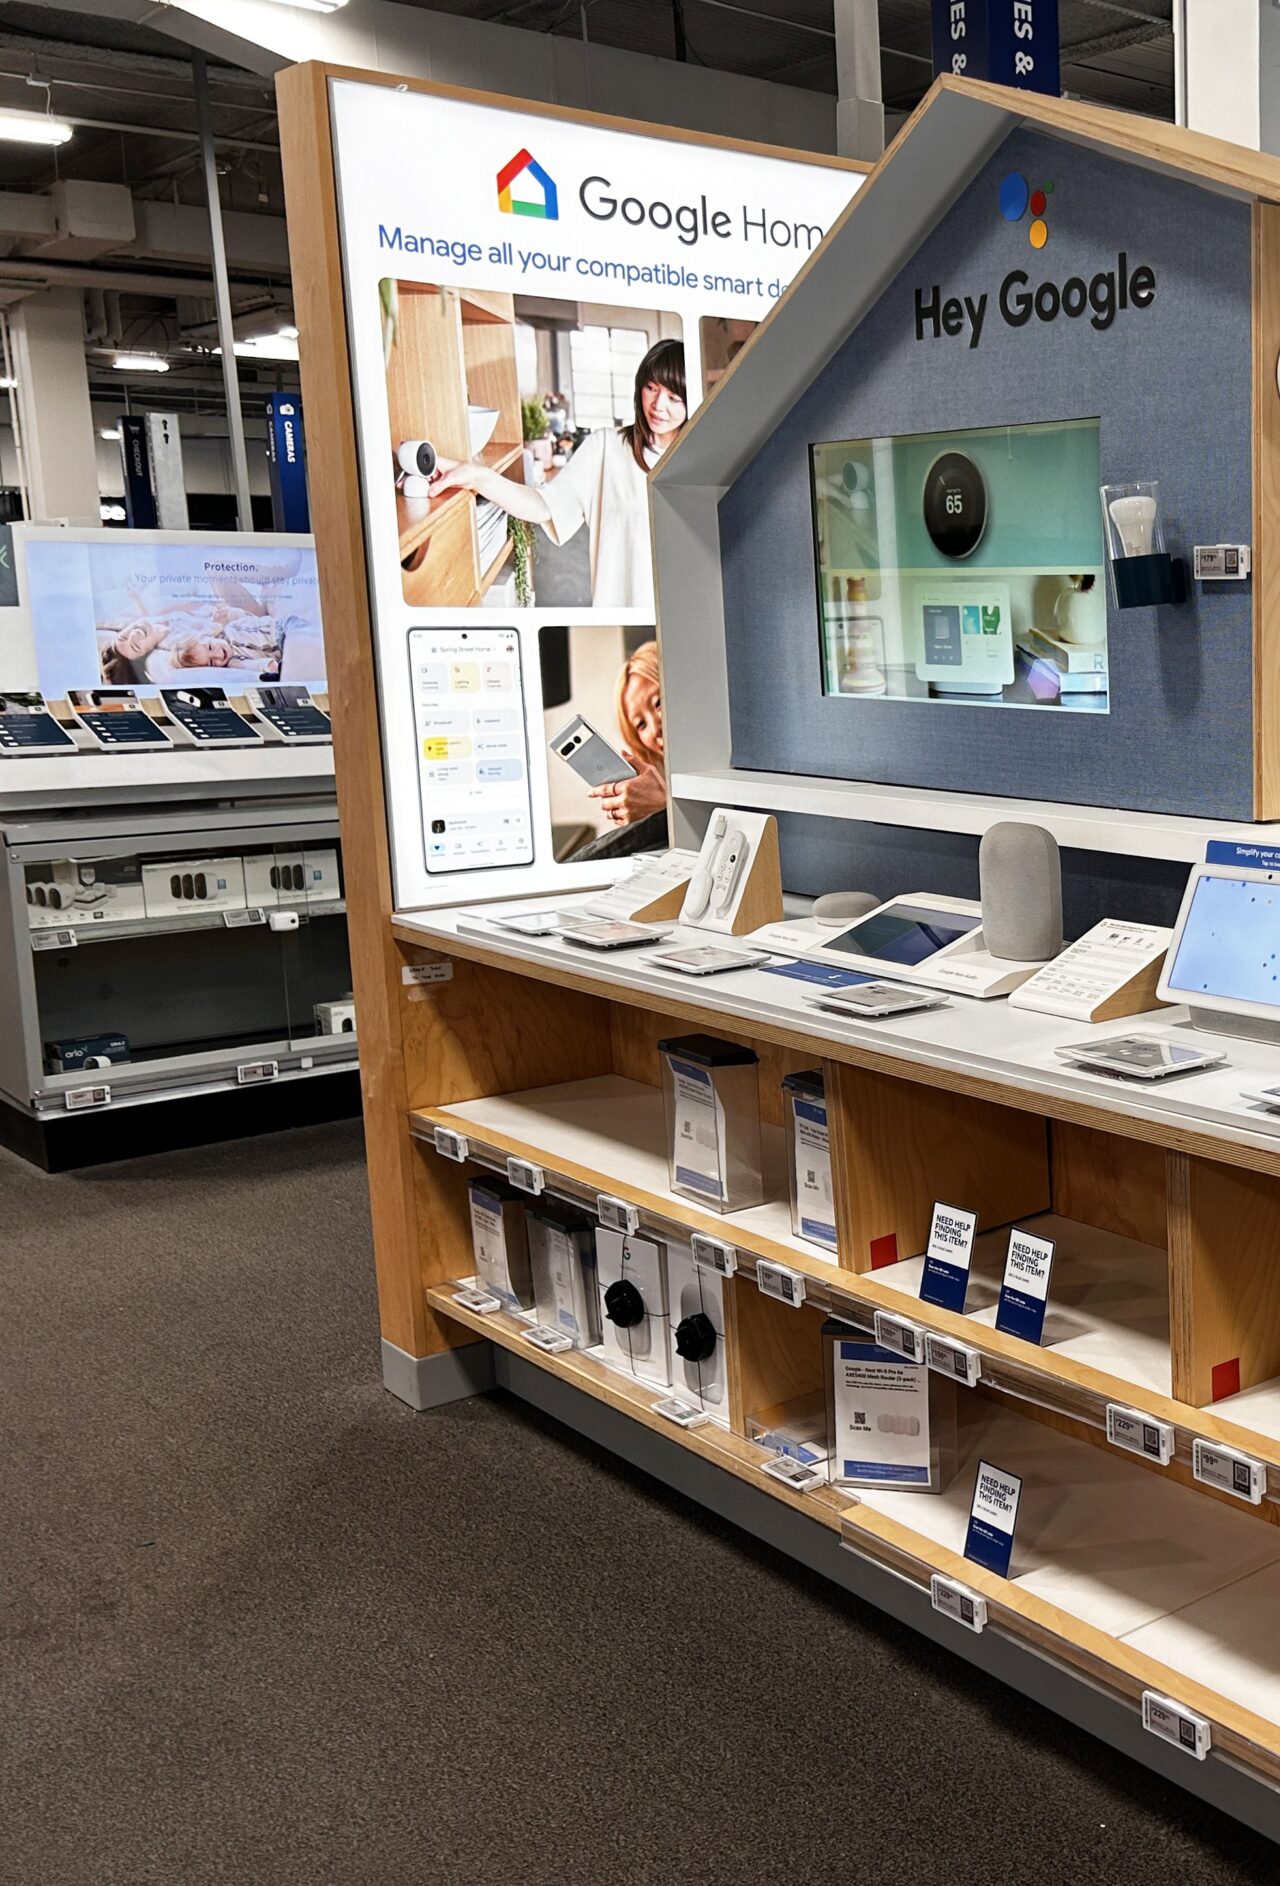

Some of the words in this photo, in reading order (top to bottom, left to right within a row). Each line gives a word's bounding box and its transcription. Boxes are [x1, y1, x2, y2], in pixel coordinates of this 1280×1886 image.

[950, 0, 966, 40] ES
[1013, 0, 1033, 40] ES
[1015, 51, 1034, 76] &
[578, 175, 732, 247] Google
[742, 205, 824, 251] Hom
[378, 224, 483, 266] Manage
[488, 241, 514, 266] all
[517, 248, 572, 275] your
[575, 257, 699, 294] compatible
[702, 273, 764, 298] smart
[914, 285, 988, 349] Hey
[1000, 252, 1156, 331] Google
[284, 420, 296, 463] CAMERAS
[131, 439, 144, 478] CHECKOUT
[945, 494, 963, 515] 65
[204, 562, 259, 572] Protection.
[134, 574, 157, 583] Your
[159, 574, 192, 585] private
[193, 575, 238, 584] moments
[239, 574, 270, 585] should
[272, 576, 290, 586] stay
[291, 576, 318, 586] privat
[1235, 847, 1260, 858] Simplify
[1260, 852, 1274, 860] your
[65, 1048, 85, 1059] arlo
[934, 1222, 962, 1238] FINDING
[936, 1214, 954, 1227] NEED
[954, 1220, 971, 1232] HELP
[933, 1230, 948, 1242] THIS
[948, 1235, 968, 1249] ITEM?
[1011, 1250, 1039, 1268] FINDING
[1012, 1241, 1031, 1256] NEED
[1031, 1249, 1048, 1261] HELP
[1010, 1259, 1025, 1271] THIS
[1025, 1265, 1045, 1279] ITEM?
[979, 1482, 1007, 1502] FINDING
[981, 1474, 999, 1488] NEED
[999, 1483, 1016, 1496] HELP
[978, 1491, 992, 1504] THIS
[993, 1498, 1013, 1514] ITEM?
